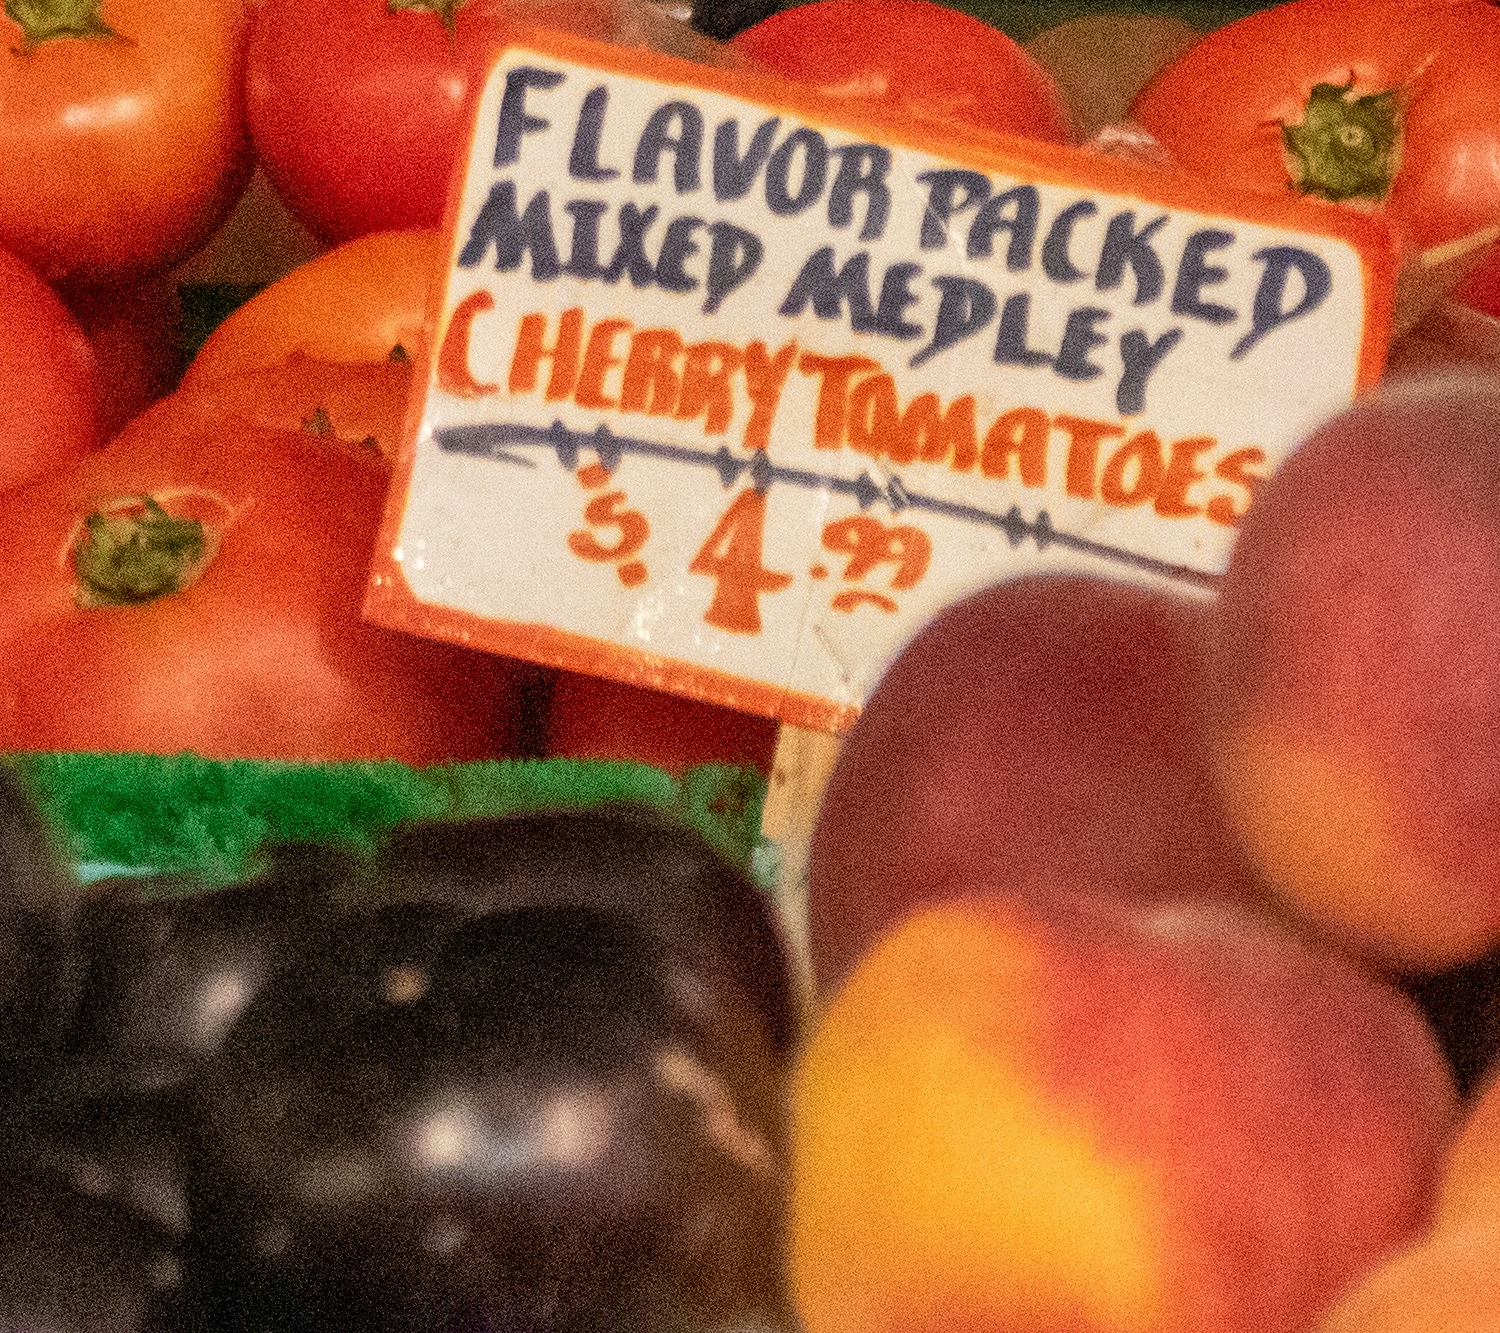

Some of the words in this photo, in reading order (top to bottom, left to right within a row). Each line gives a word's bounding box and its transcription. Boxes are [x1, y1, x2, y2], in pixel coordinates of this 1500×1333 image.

[457, 179, 764, 315] MIXED
[778, 244, 1185, 415] MEDLEY
[493, 64, 893, 246] FLAVOR
[915, 166, 1334, 361] PACKED
[436, 289, 801, 451] CHERRY
[801, 351, 1272, 529] TOMATOES
